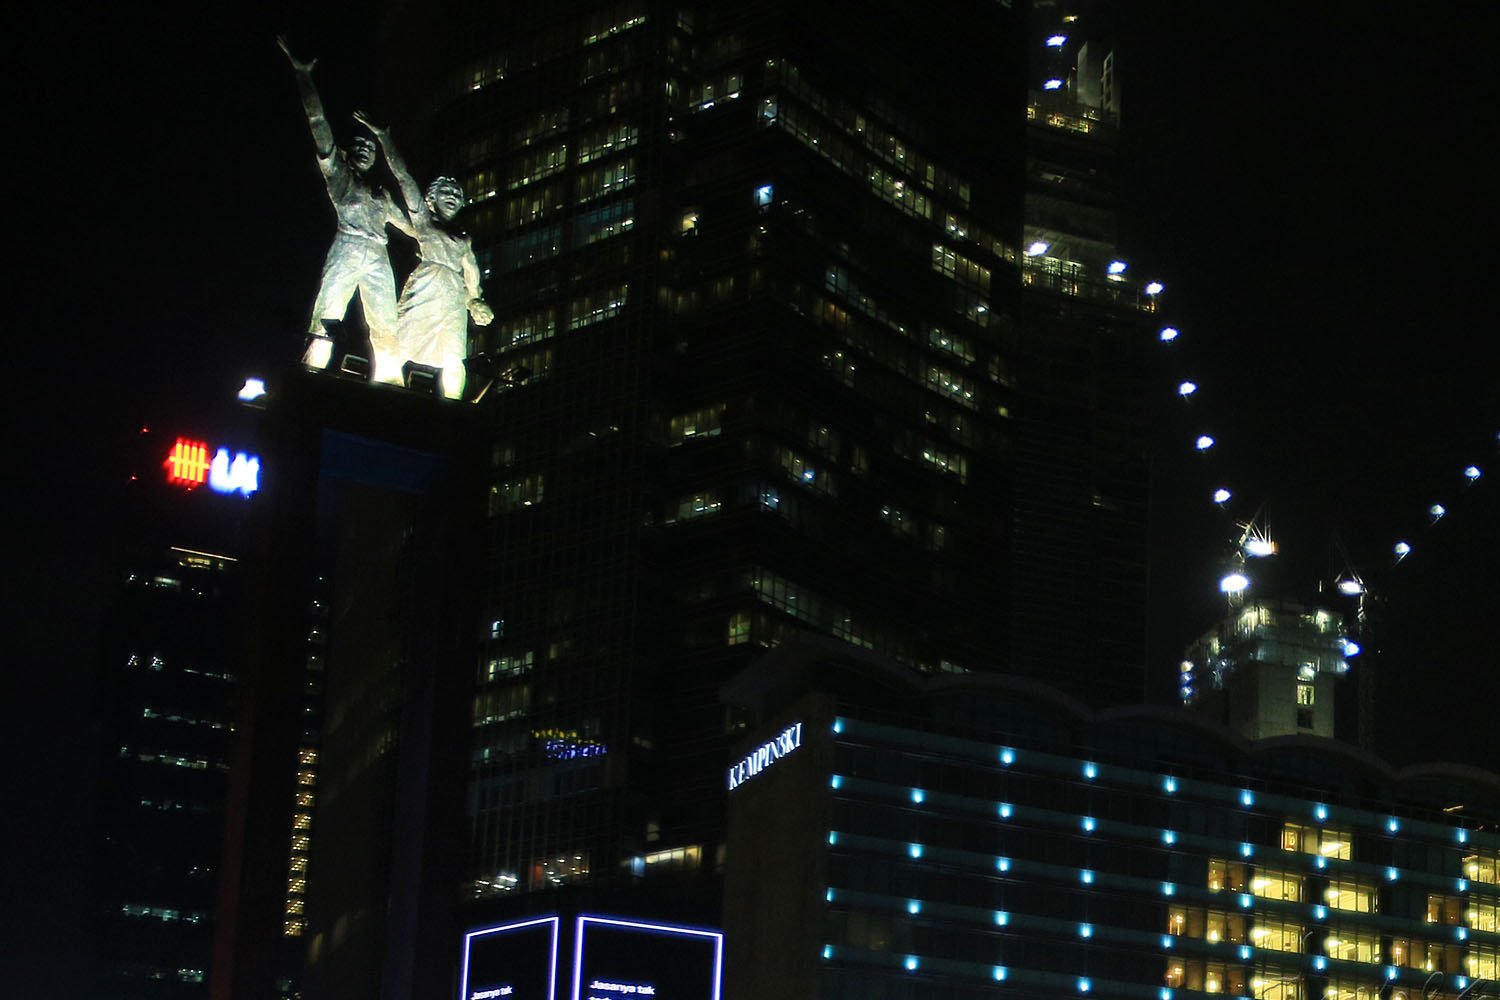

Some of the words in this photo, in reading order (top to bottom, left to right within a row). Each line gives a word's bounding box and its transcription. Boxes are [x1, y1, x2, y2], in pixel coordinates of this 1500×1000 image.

[728, 722, 803, 791] KEMPINSKI
[590, 981, 636, 994] Jasanya
[637, 986, 655, 995] tak
